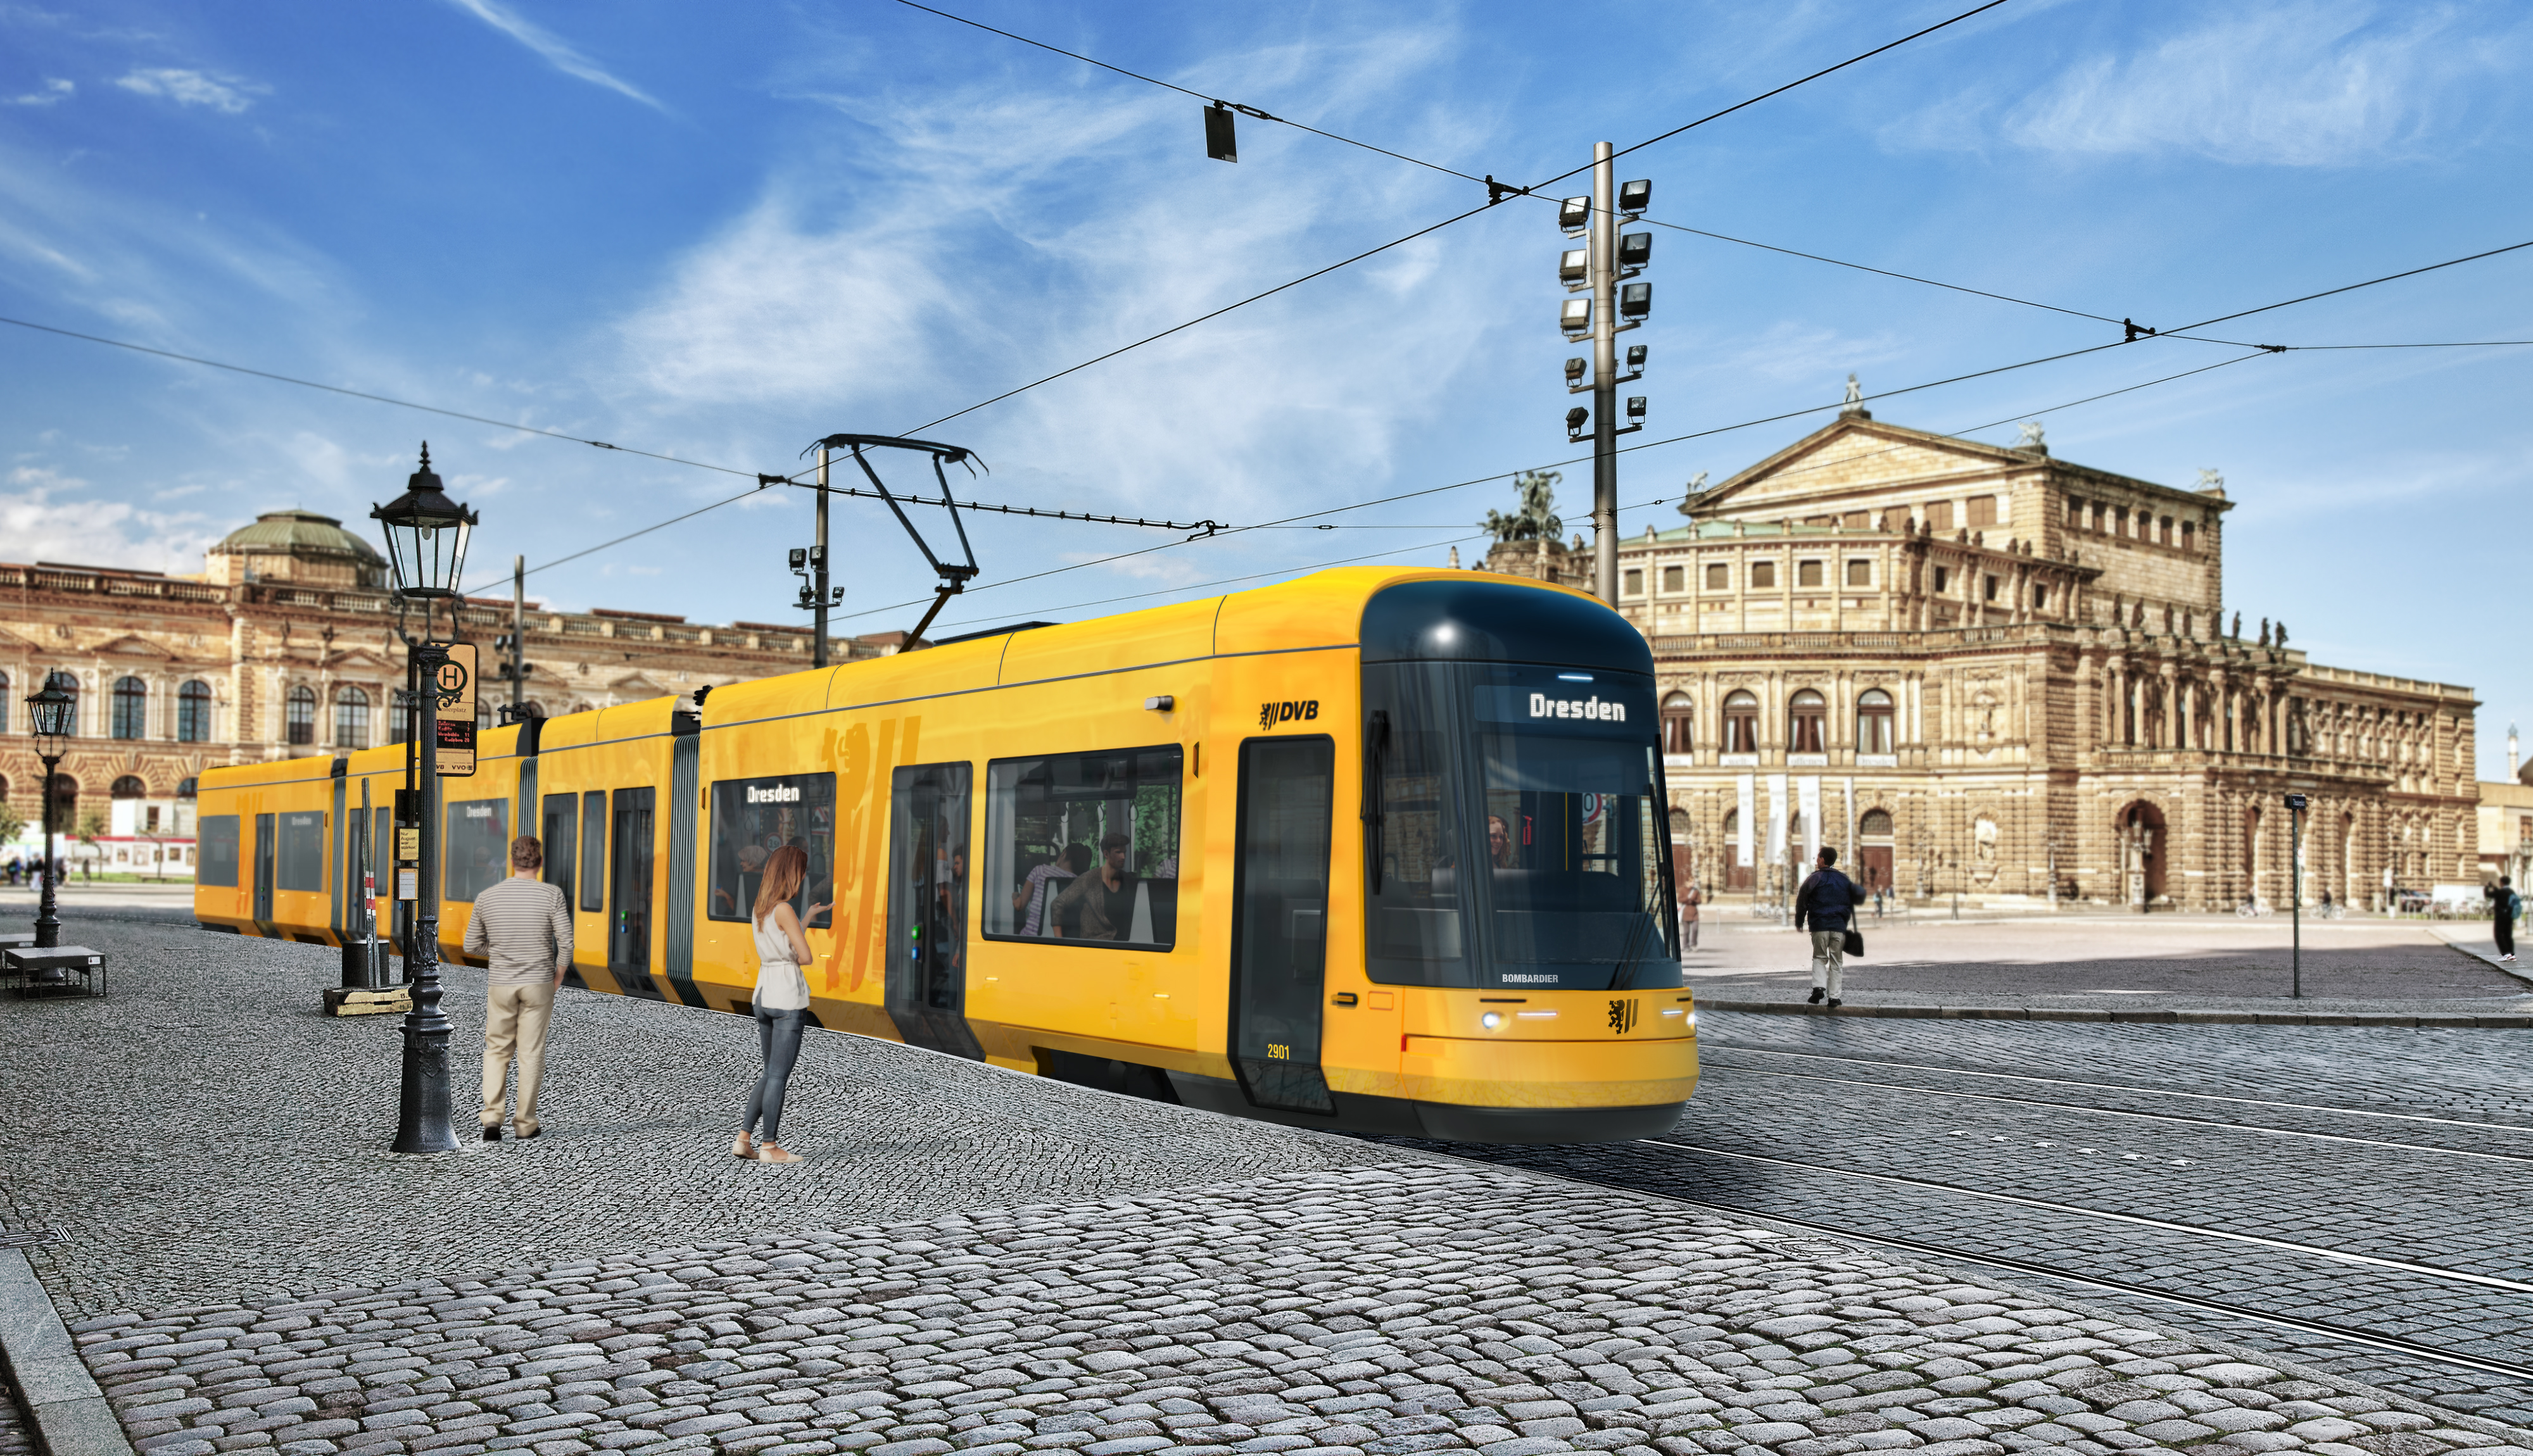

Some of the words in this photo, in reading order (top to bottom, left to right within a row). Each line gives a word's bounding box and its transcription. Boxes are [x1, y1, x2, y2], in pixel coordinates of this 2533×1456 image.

[443, 667, 457, 686] H
[1279, 700, 1319, 721] DVB
[1531, 693, 1625, 721] Dresden
[747, 784, 799, 803] Dresden
[467, 805, 491, 817] Dresden
[292, 816, 312, 825] Dresden
[1502, 974, 1558, 983] BOMBARDIER
[1268, 1043, 1289, 1060] 2901
